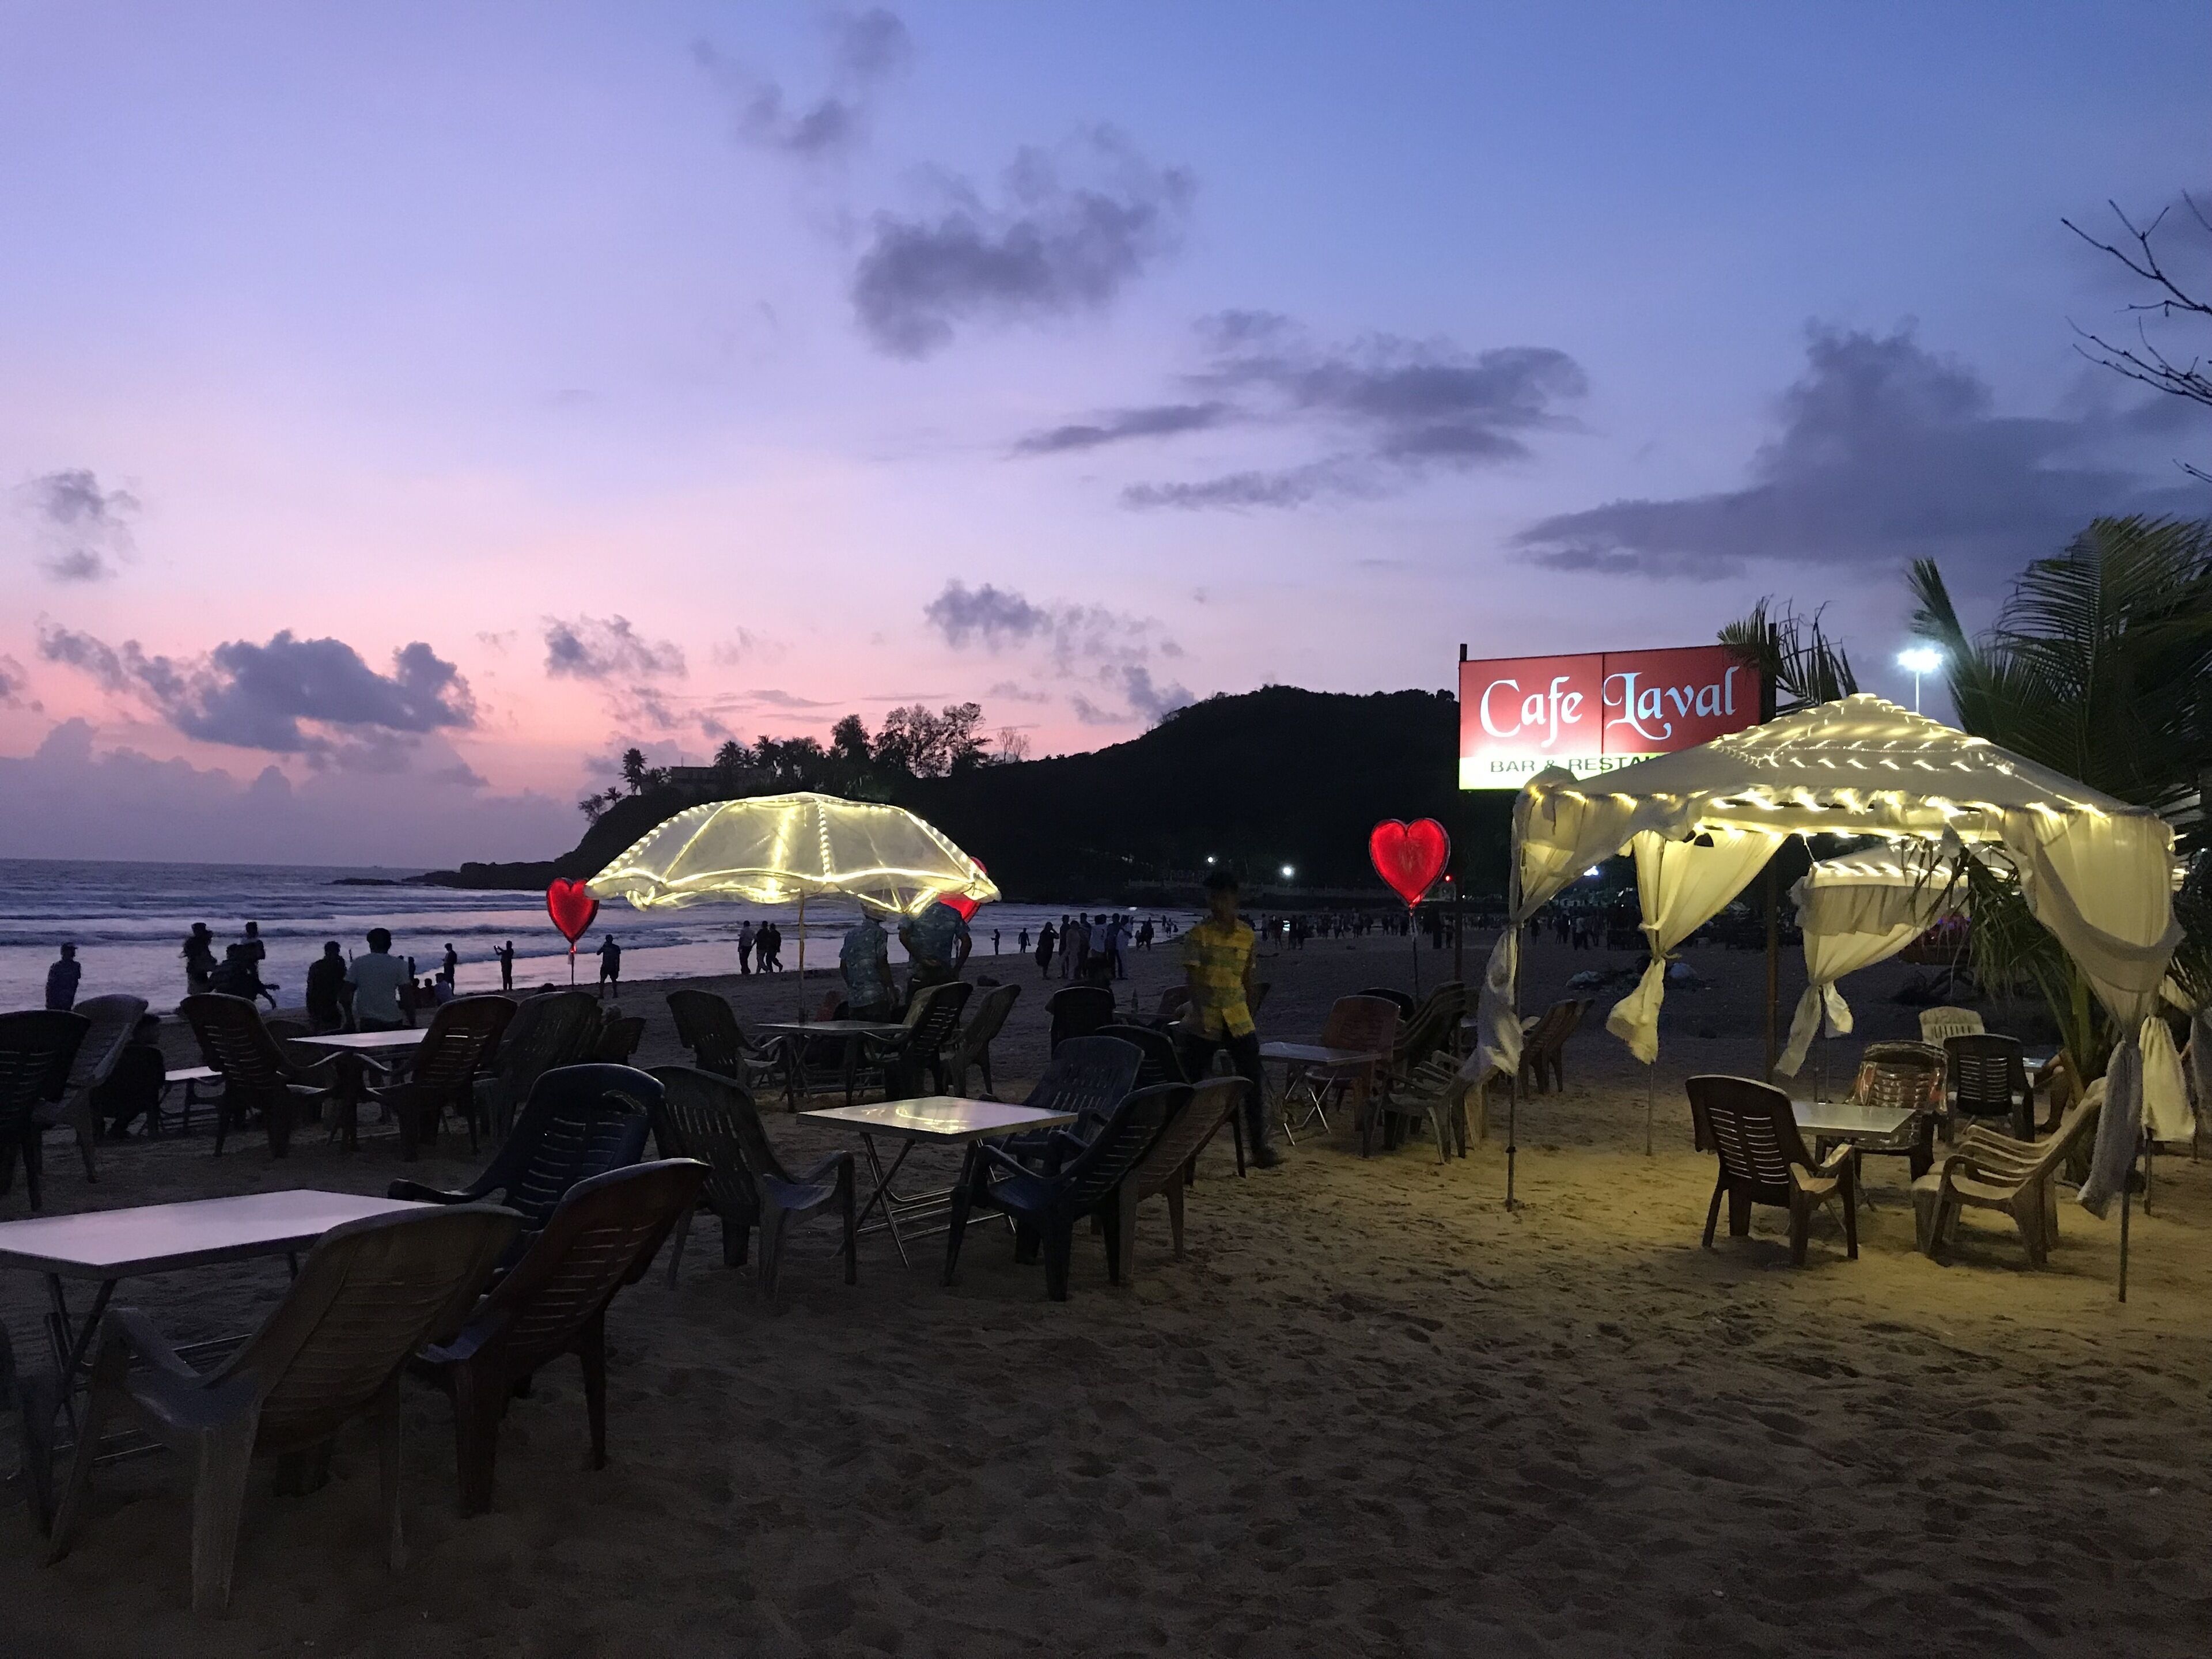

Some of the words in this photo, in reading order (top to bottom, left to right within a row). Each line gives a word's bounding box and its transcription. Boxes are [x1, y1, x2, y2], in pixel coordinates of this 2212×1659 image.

[1480, 676, 1583, 748] Cafe
[1603, 666, 1740, 740] Laval
[1490, 760, 1535, 772] BAR
